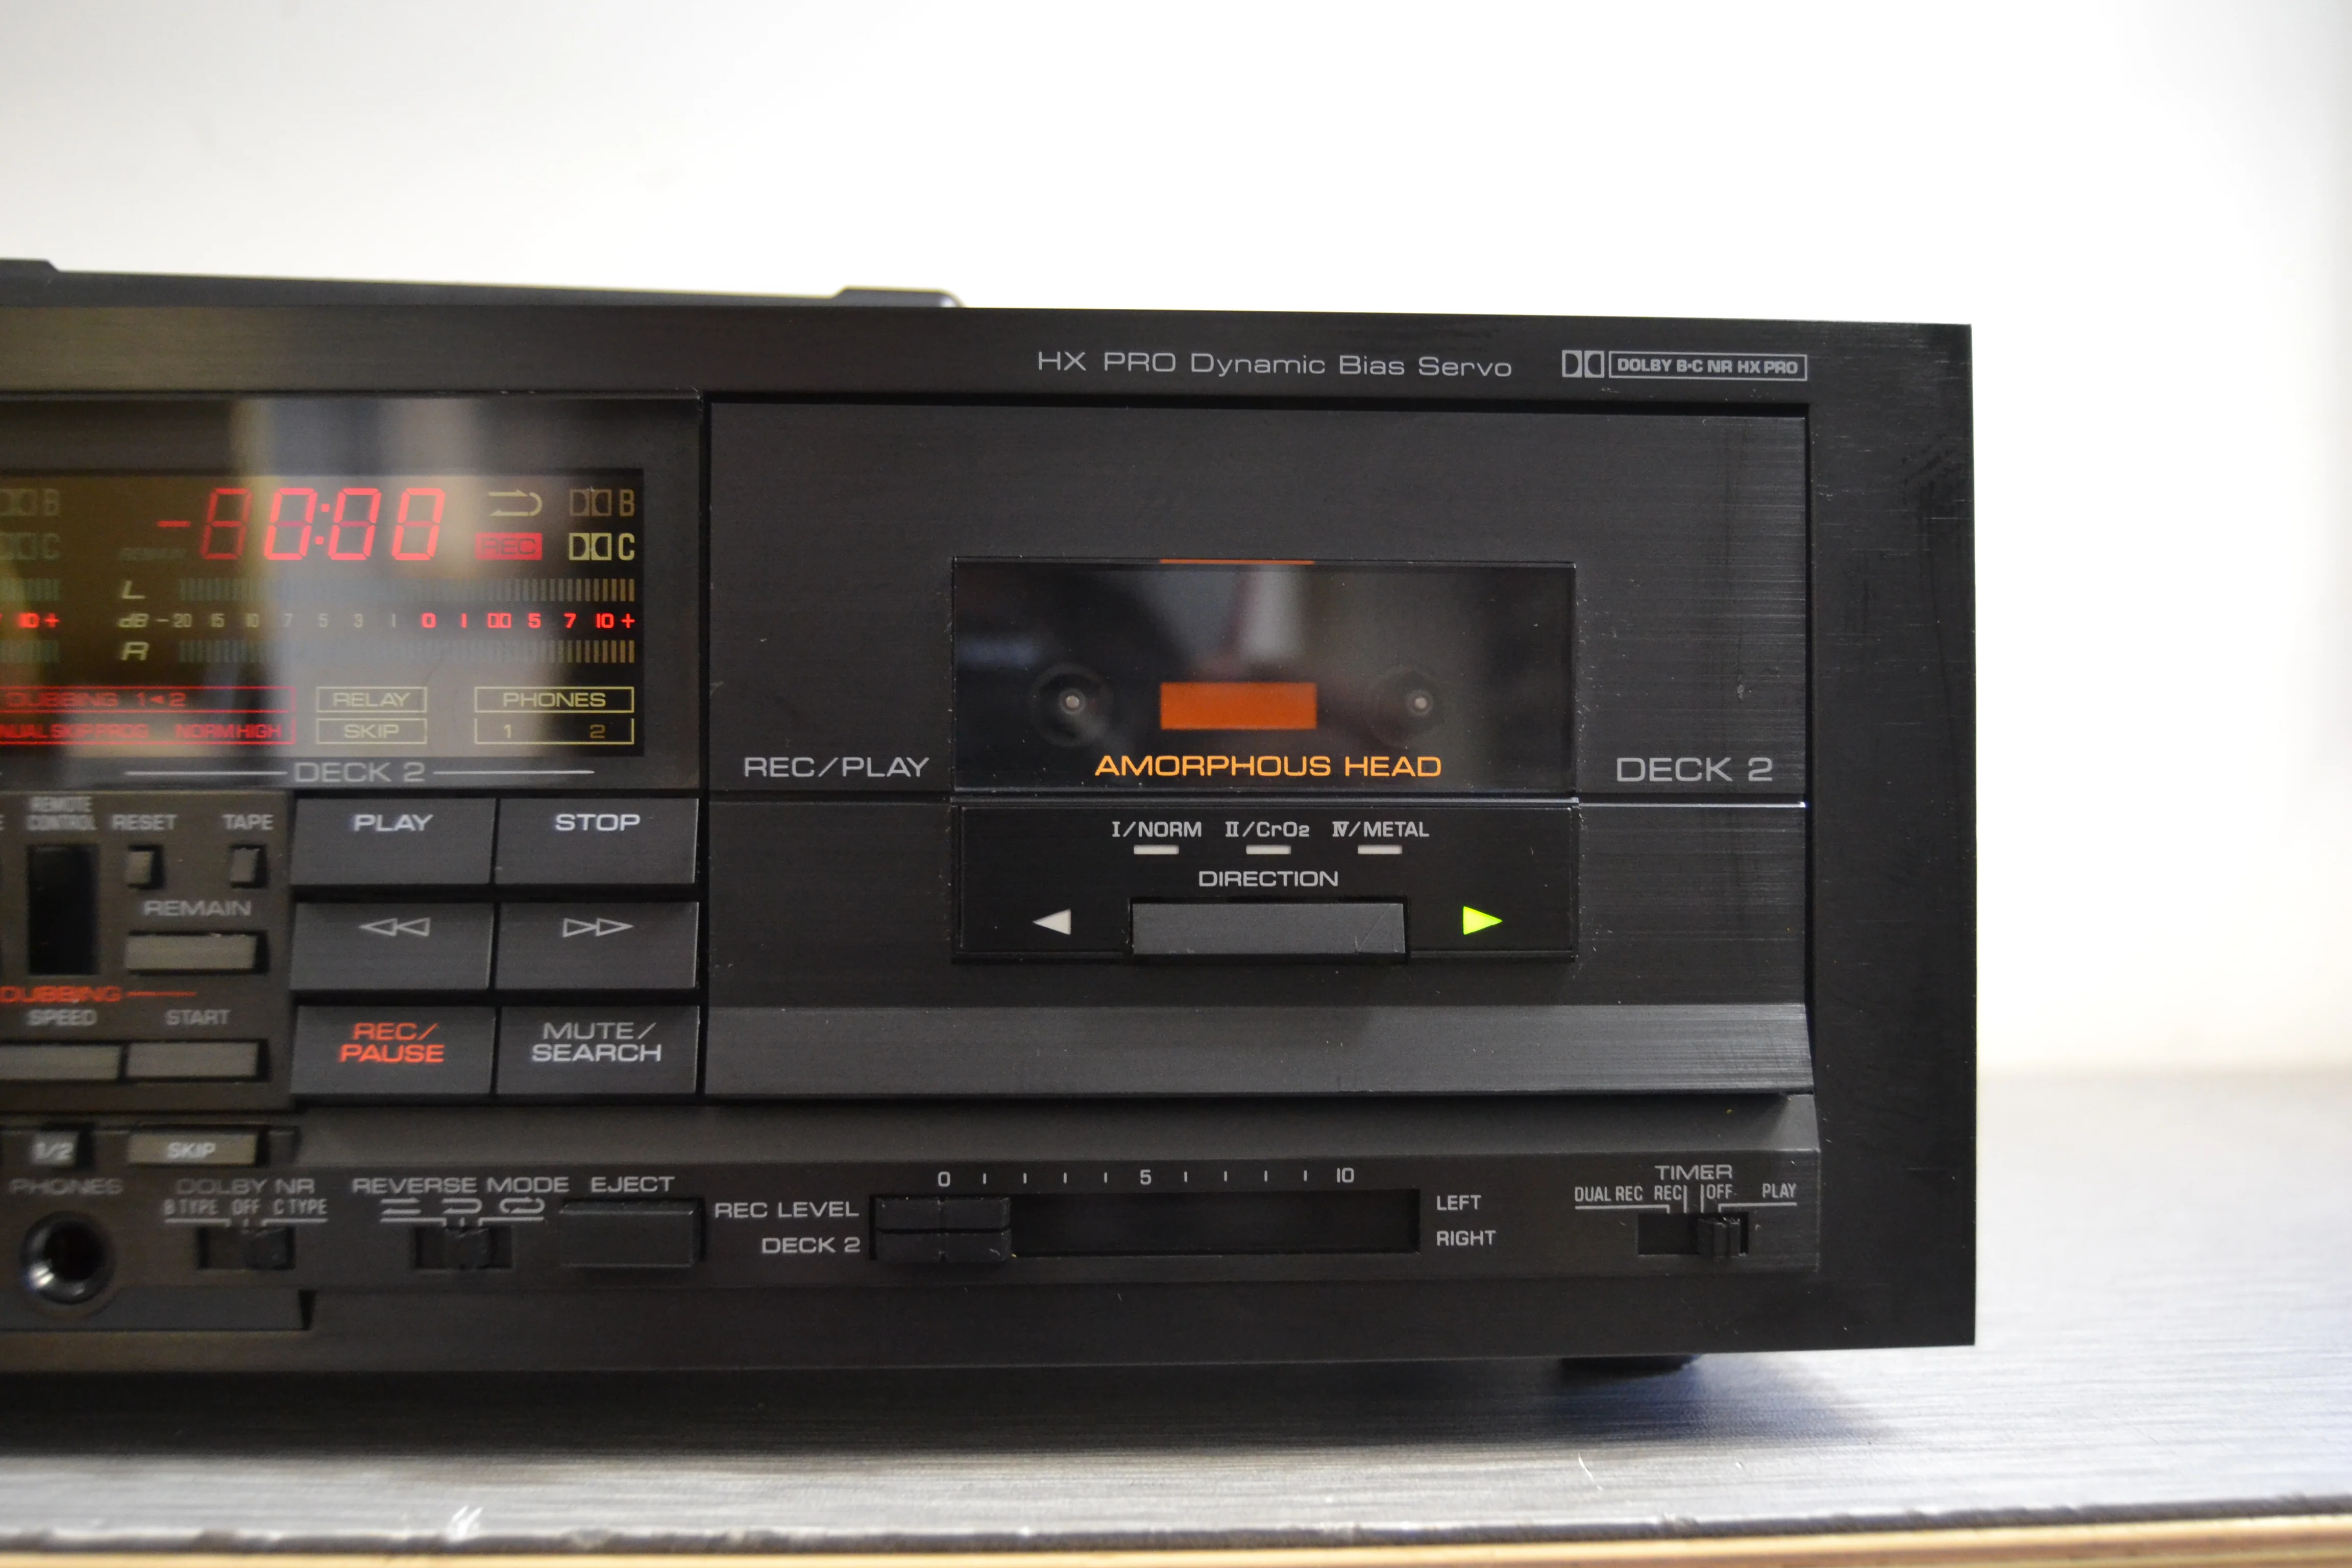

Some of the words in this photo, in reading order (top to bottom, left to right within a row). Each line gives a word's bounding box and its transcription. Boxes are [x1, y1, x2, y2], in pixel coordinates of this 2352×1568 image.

[1038, 351, 1086, 371] HX
[1105, 352, 1176, 372] PRO
[1191, 353, 1326, 377] Dynamic
[1339, 355, 1405, 375] Bias
[1418, 356, 1512, 377] Servo
[1617, 358, 1672, 372] DOLBY
[1707, 360, 1733, 373] NR
[1737, 361, 1761, 374] HX
[1763, 361, 1798, 374] PRO
[479, 537, 537, 555] REC
[121, 580, 146, 599] L
[118, 613, 150, 628] dB
[210, 614, 226, 628] 15
[282, 614, 293, 628] 7
[318, 614, 328, 628] 5
[354, 614, 363, 628] 3
[422, 613, 436, 628] 0
[528, 613, 542, 628] 5
[564, 613, 577, 628] 7
[120, 641, 151, 661] R
[333, 692, 410, 707] RELAY
[503, 692, 606, 707] PHONES
[344, 723, 399, 739] SKIP
[590, 723, 606, 739] 2
[293, 762, 392, 783] DECK
[403, 762, 426, 783] 2
[744, 756, 930, 777] REC/PLAY
[1095, 755, 1331, 777] AMORPHOUS
[1345, 756, 1442, 777] HEAD
[1616, 757, 1733, 782] DECK
[1748, 757, 1773, 781] 2
[111, 814, 178, 831] RESET
[223, 814, 274, 831] TAPE
[353, 814, 434, 832] PLAY
[554, 814, 641, 832] STOP
[1198, 871, 1338, 888] DIRECTION
[142, 899, 252, 917] REMAIN
[27, 1008, 98, 1027] SPEED
[164, 1009, 232, 1026] START
[353, 1022, 438, 1041] REC/
[543, 1022, 657, 1040] MUTE/
[339, 1043, 445, 1063] PAUSE
[531, 1043, 662, 1063] SEARCH
[166, 1141, 217, 1160] SKIP
[938, 1171, 951, 1187] 0
[1140, 1169, 1153, 1186] 5
[1336, 1167, 1355, 1184] 10
[1655, 1164, 1733, 1180] TIMER
[8, 1177, 124, 1195] PHONES
[175, 1178, 268, 1195] DOLBY
[275, 1178, 315, 1195] NR
[352, 1177, 477, 1194] REVERSE
[486, 1177, 569, 1194] MODE
[590, 1176, 675, 1193] EJECT
[1575, 1186, 1611, 1202] DUAL
[1615, 1186, 1643, 1202] REC
[1654, 1185, 1682, 1200] REC
[1706, 1184, 1733, 1199] OFF
[1762, 1183, 1797, 1199] PLAY
[180, 1199, 219, 1215] TYPE
[232, 1199, 261, 1215] OFF
[288, 1199, 328, 1215] TYPE
[715, 1202, 769, 1219] REC
[778, 1201, 860, 1218] LEVEL
[1437, 1194, 1481, 1211] LEFT
[762, 1237, 836, 1254] DECK
[844, 1237, 861, 1253] 2
[1437, 1229, 1497, 1247] RIGHT
